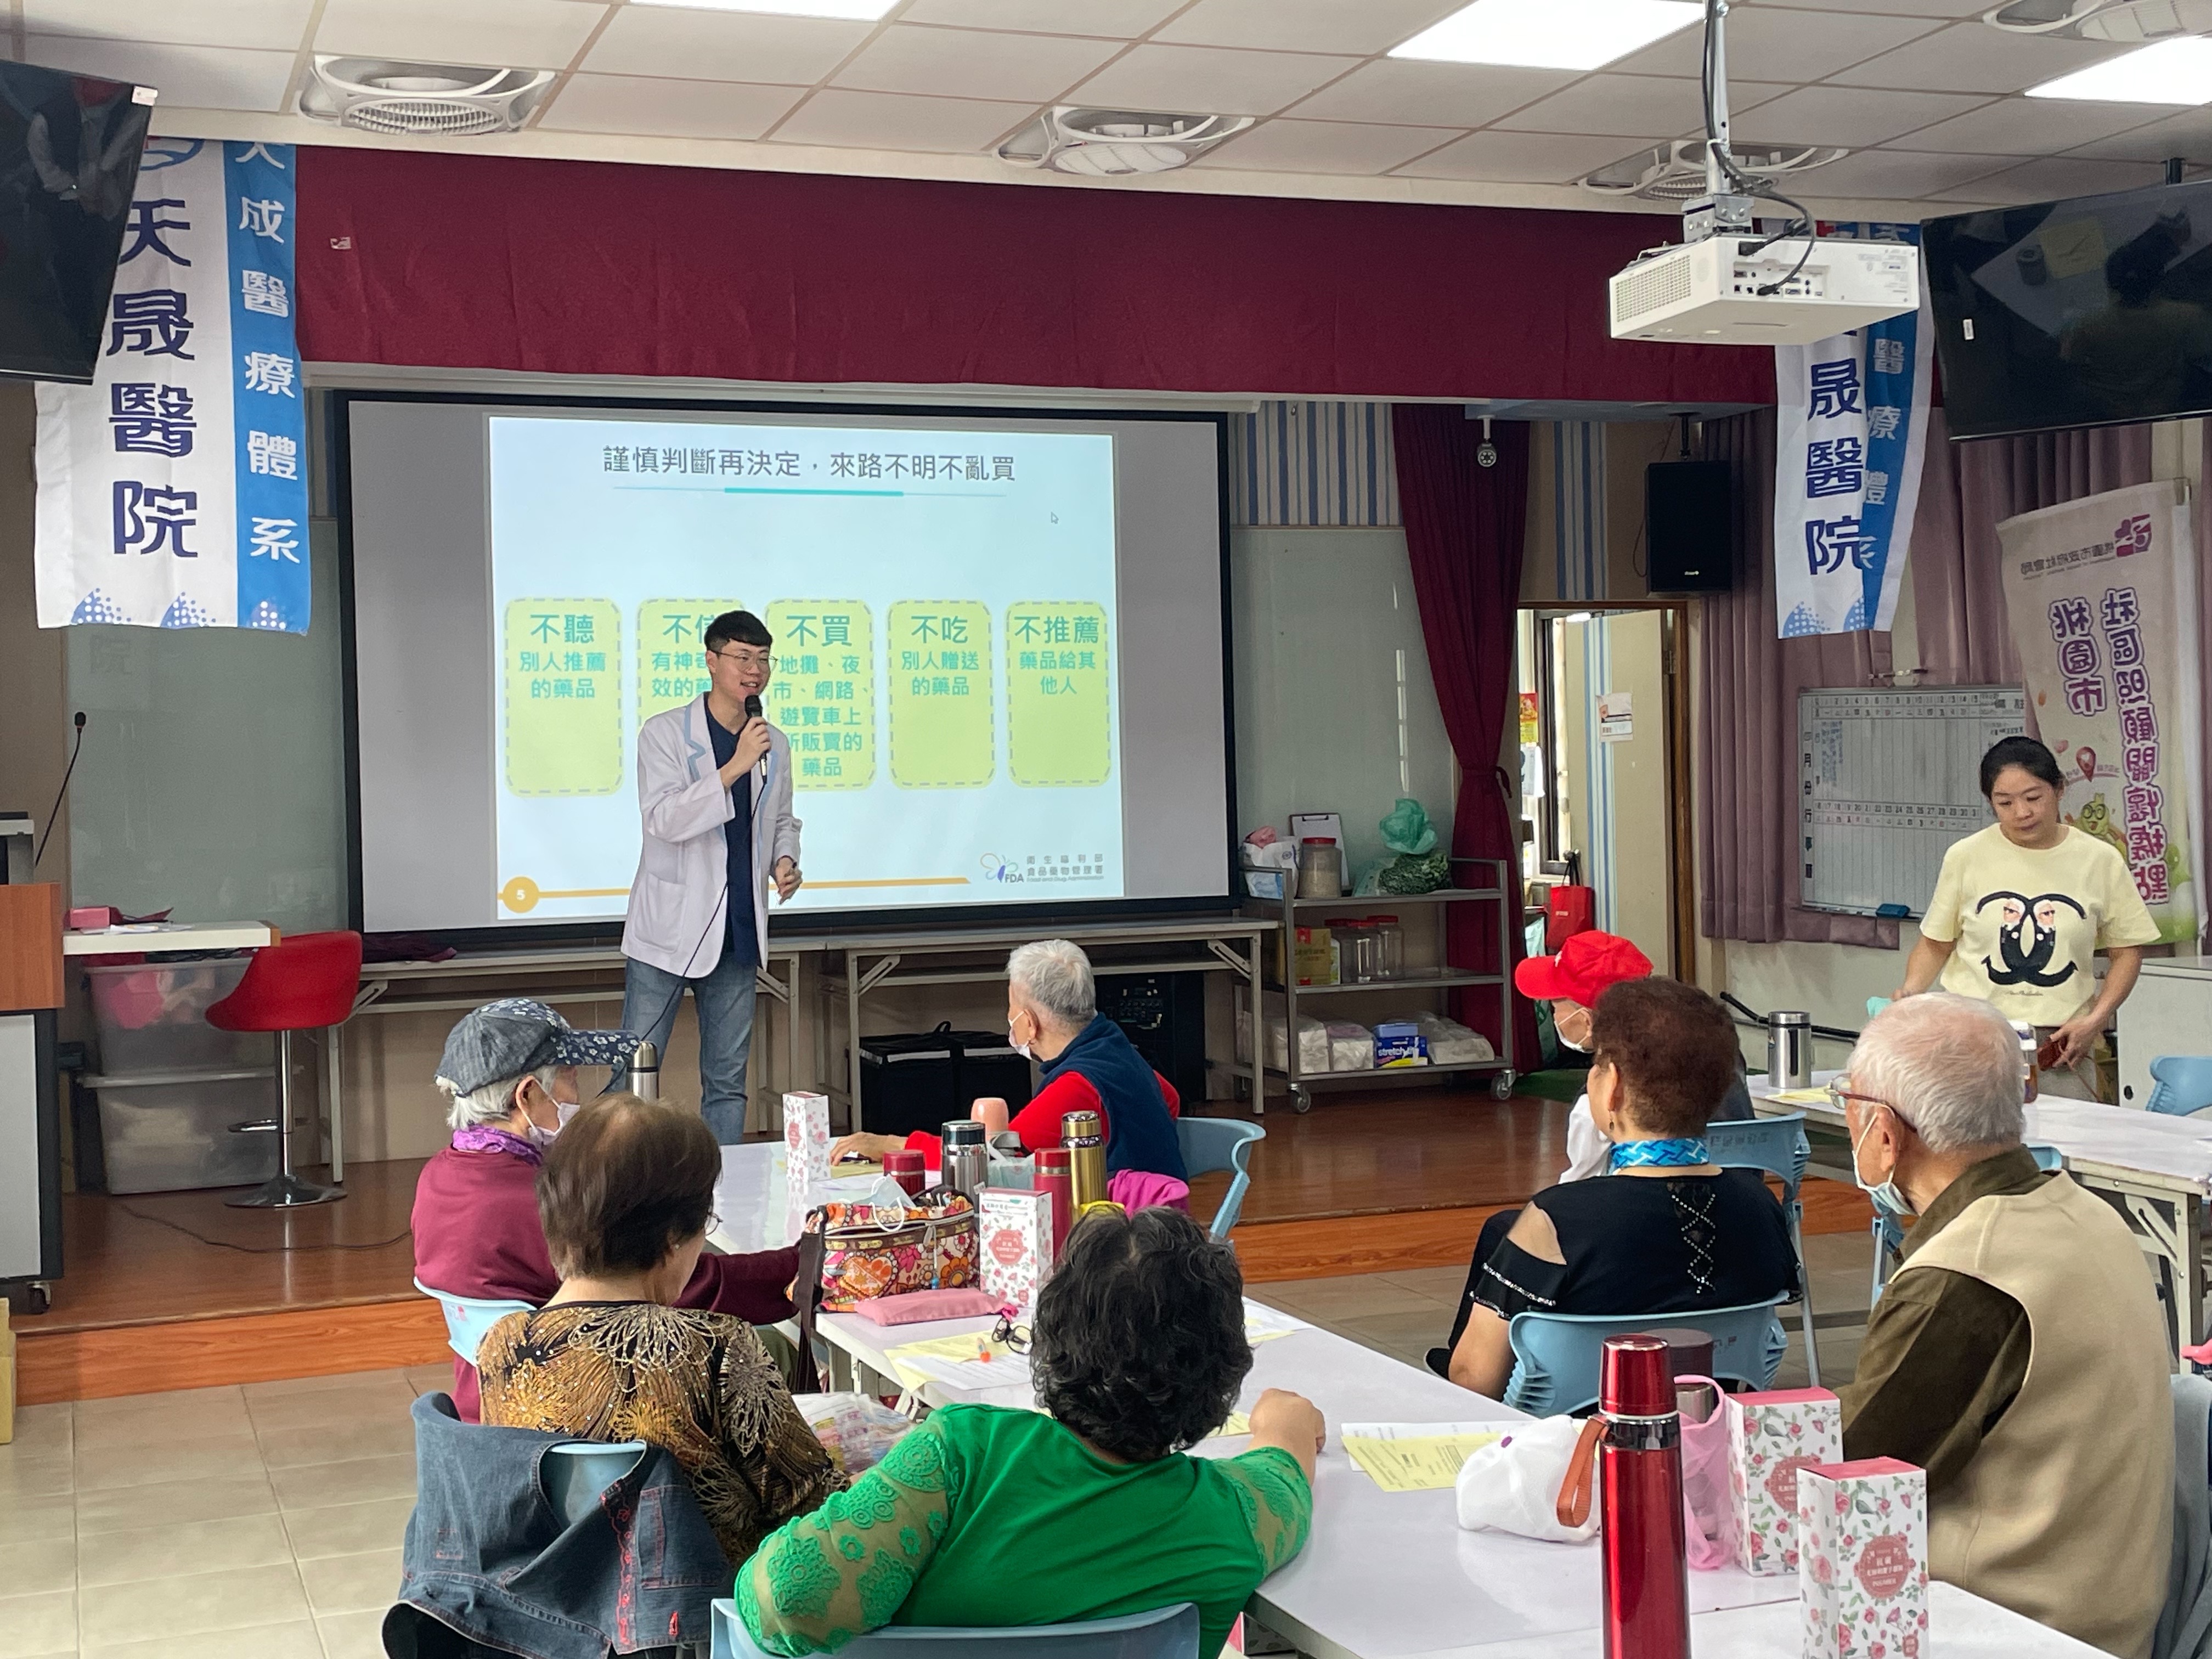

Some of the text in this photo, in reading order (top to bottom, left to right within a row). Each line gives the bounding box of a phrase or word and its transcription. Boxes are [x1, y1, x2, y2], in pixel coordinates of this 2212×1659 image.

[106, 198, 198, 558] 天晟醫院
[1805, 330, 1863, 575] 晟醫院
[530, 614, 595, 645] 不聽
[787, 615, 852, 647] 不買
[911, 615, 968, 645] 不吃
[1014, 616, 1099, 645] 不推薦
[520, 651, 606, 673] 別人推薦
[901, 651, 979, 671] 別人贈送
[1019, 651, 1096, 671] 藥品給其
[532, 677, 595, 699] 的藥品
[912, 676, 969, 697] 的藥品
[1040, 677, 1077, 696] 他人
[802, 757, 842, 777] 藥品
[1005, 874, 1024, 883] FDA
[516, 889, 525, 900] 5
